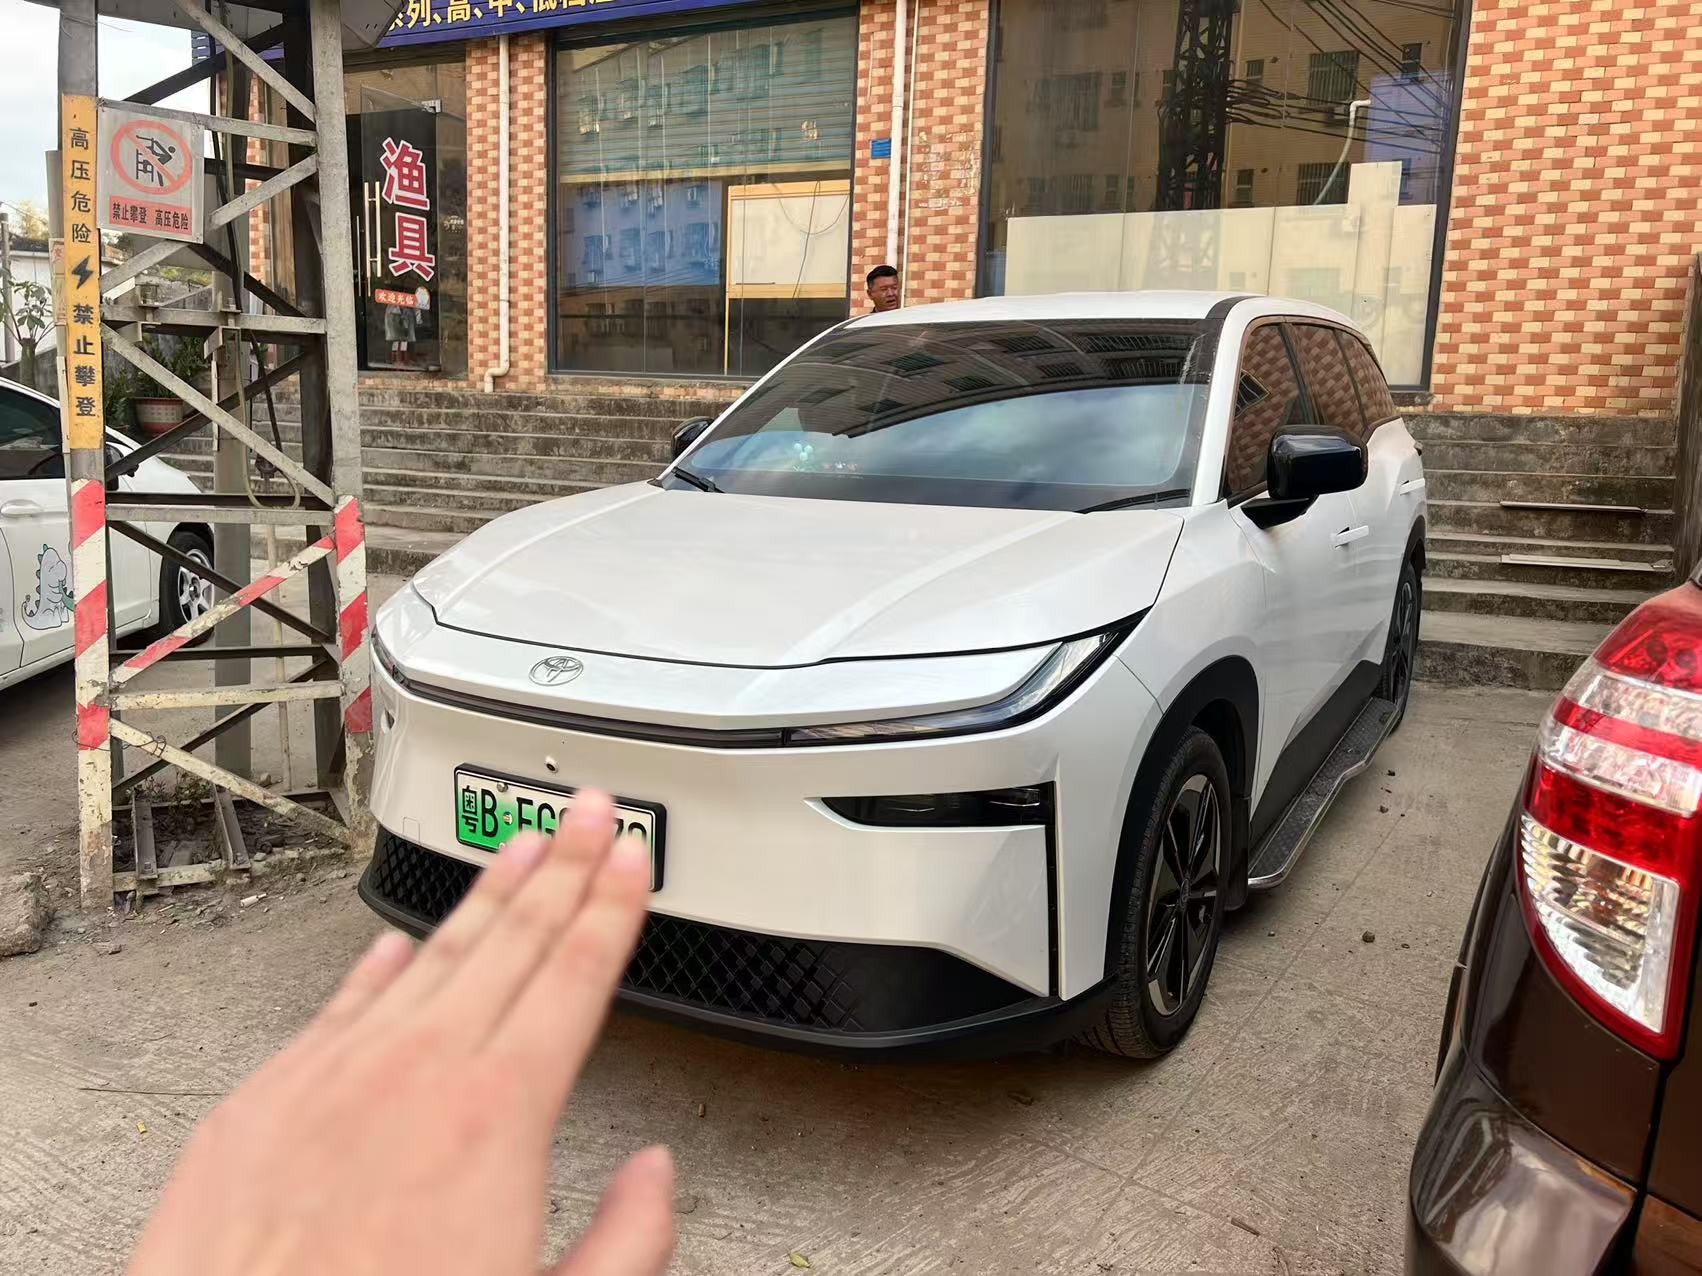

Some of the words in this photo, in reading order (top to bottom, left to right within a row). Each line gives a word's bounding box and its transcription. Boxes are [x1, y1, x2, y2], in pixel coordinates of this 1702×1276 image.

[69, 127, 92, 243] 高压危险
[112, 202, 147, 224] 禁止攀登
[155, 209, 188, 230] 高压危险
[380, 137, 435, 281] 渔具
[73, 304, 96, 417] 禁止攀登
